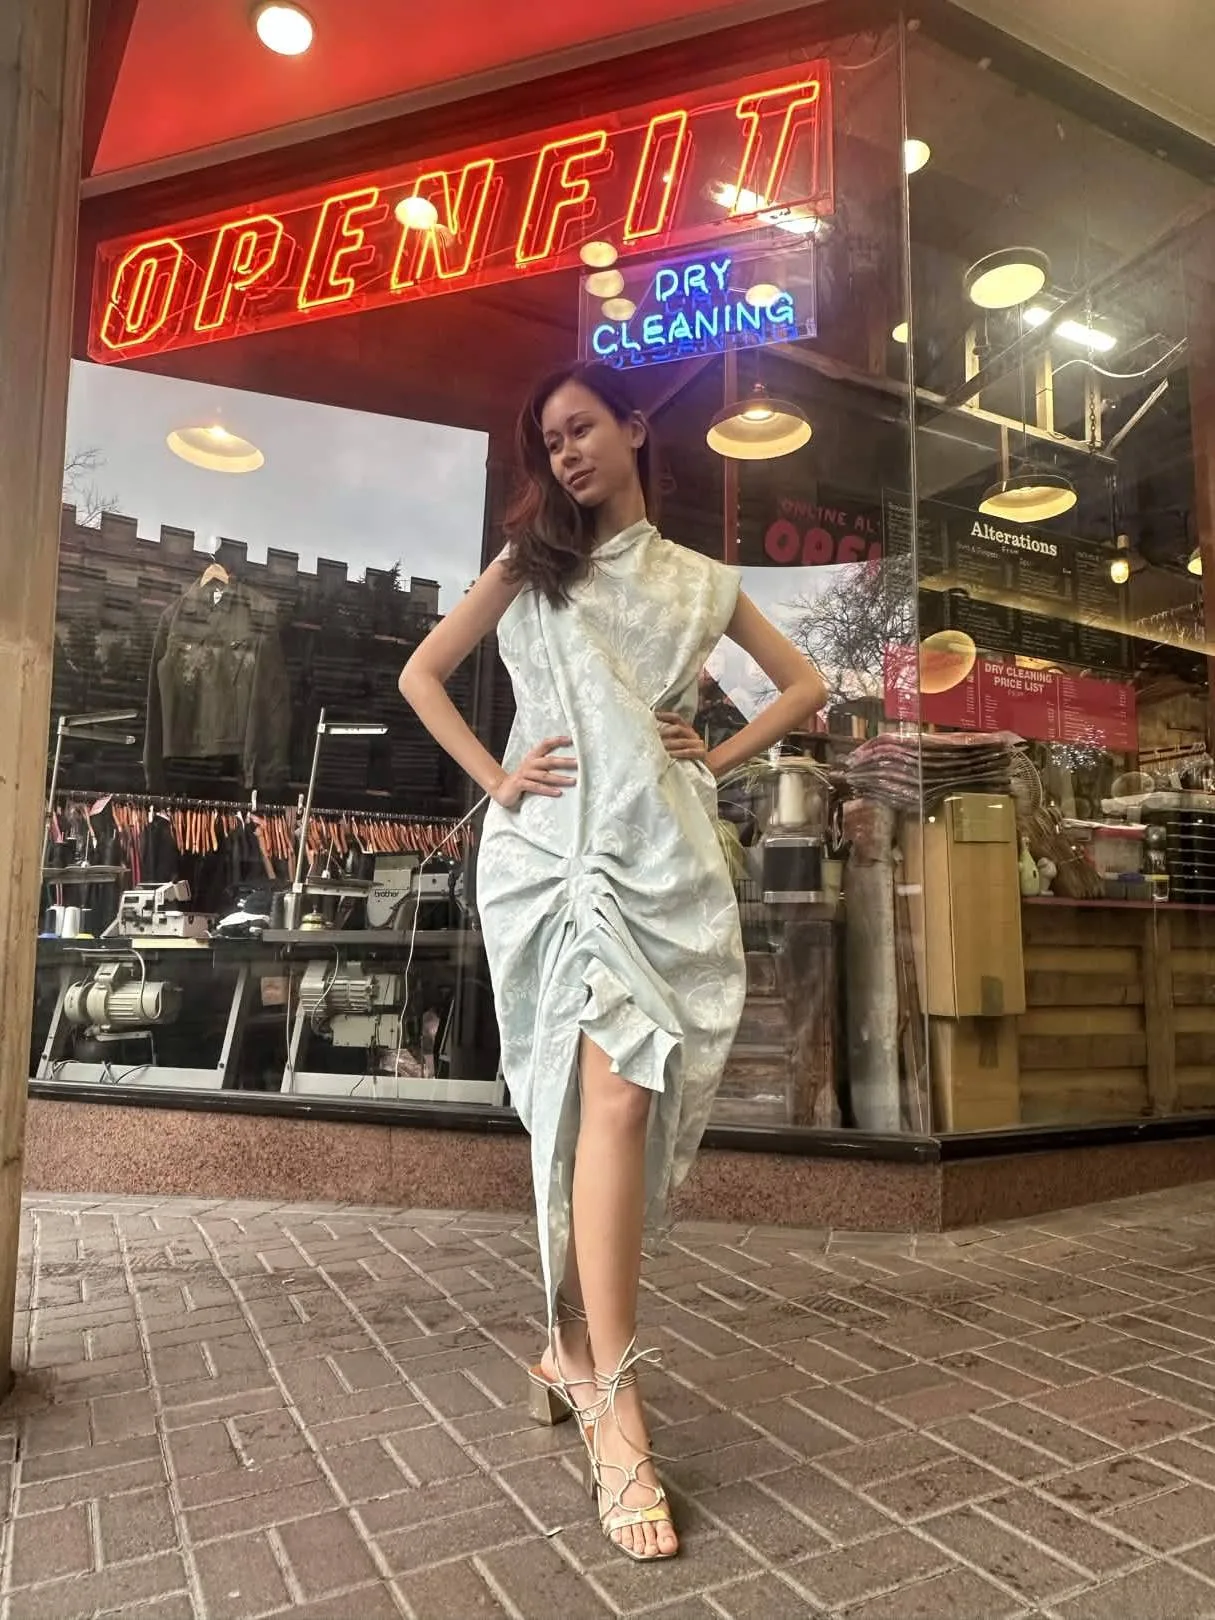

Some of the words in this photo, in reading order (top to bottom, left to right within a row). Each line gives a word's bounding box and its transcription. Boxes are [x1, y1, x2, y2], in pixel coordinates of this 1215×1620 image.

[655, 258, 731, 302] DRY
[592, 291, 794, 355] CLEANING
[781, 498, 847, 526] ONLINE
[854, 514, 881, 534] AL
[970, 520, 1058, 558] Alterations
[984, 662, 1004, 676] DRY
[1006, 666, 1053, 684] CLEANING
[993, 676, 1023, 690] PRICE
[1024, 681, 1045, 694] LIST
[374, 889, 400, 898] brother
